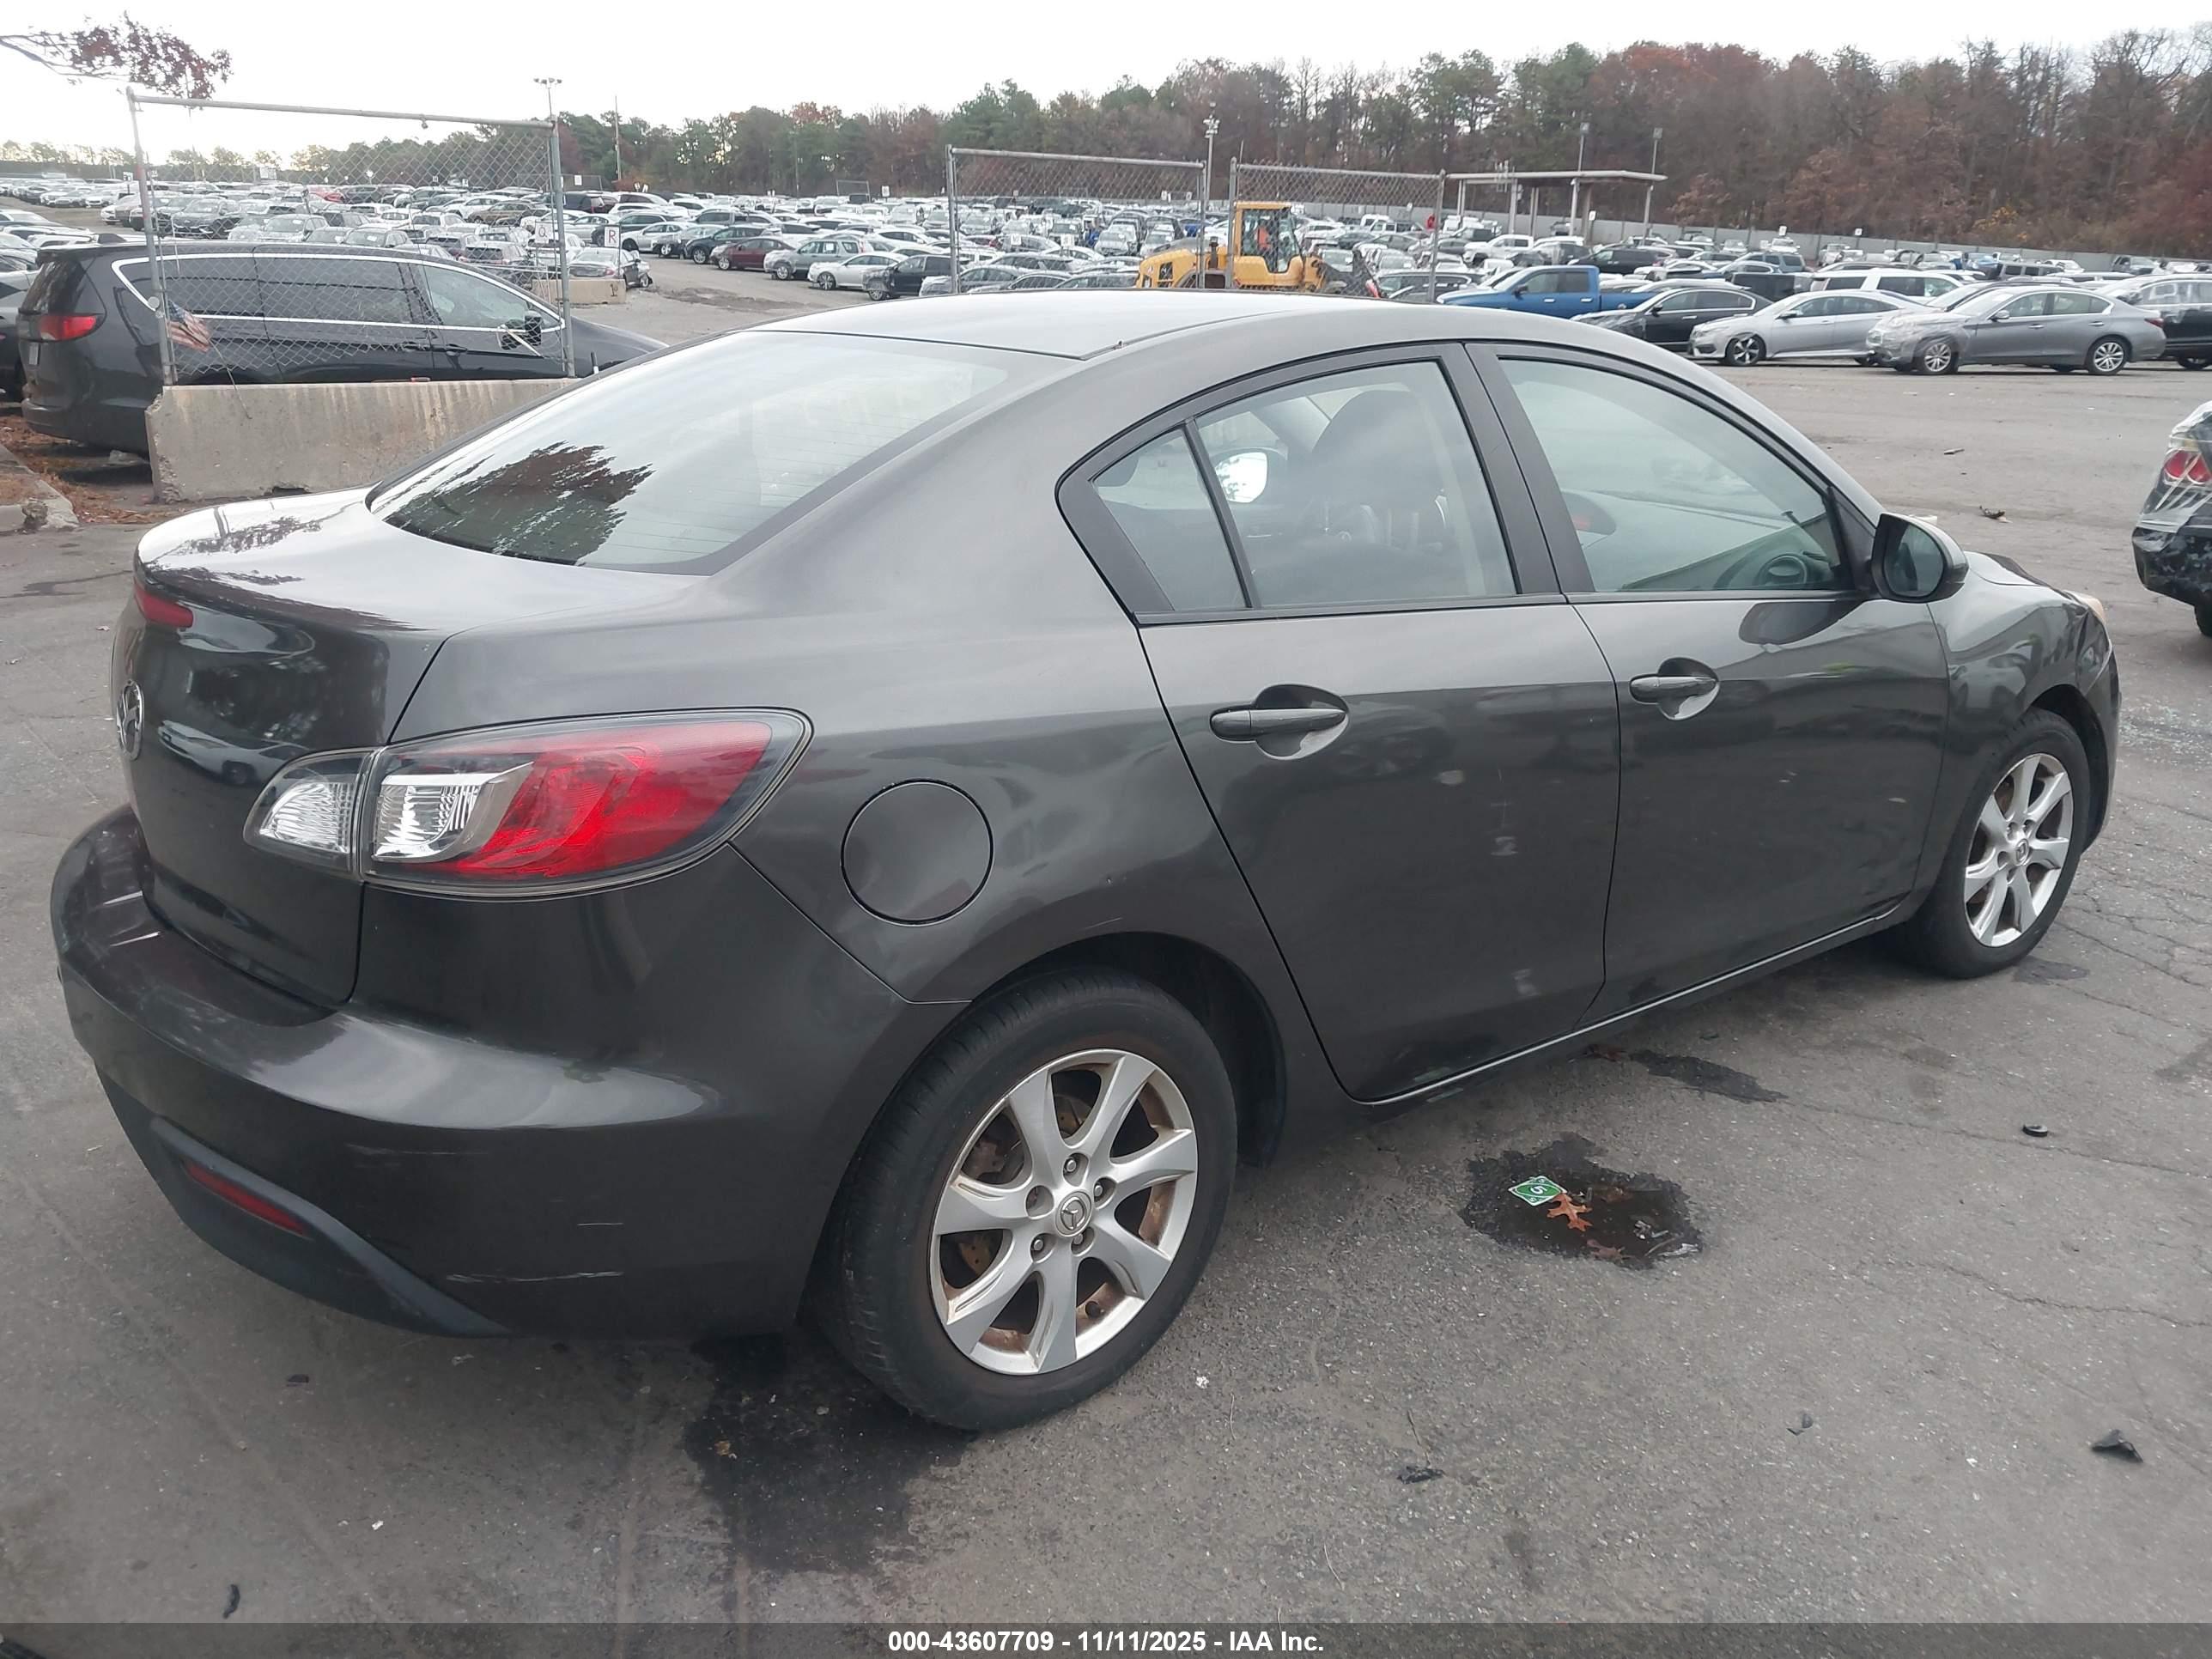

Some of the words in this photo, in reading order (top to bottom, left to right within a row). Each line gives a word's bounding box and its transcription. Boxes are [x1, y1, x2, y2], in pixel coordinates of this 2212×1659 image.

[538, 225, 548, 238] Q
[608, 229, 617, 244] R
[1530, 1185, 1548, 1194] 5
